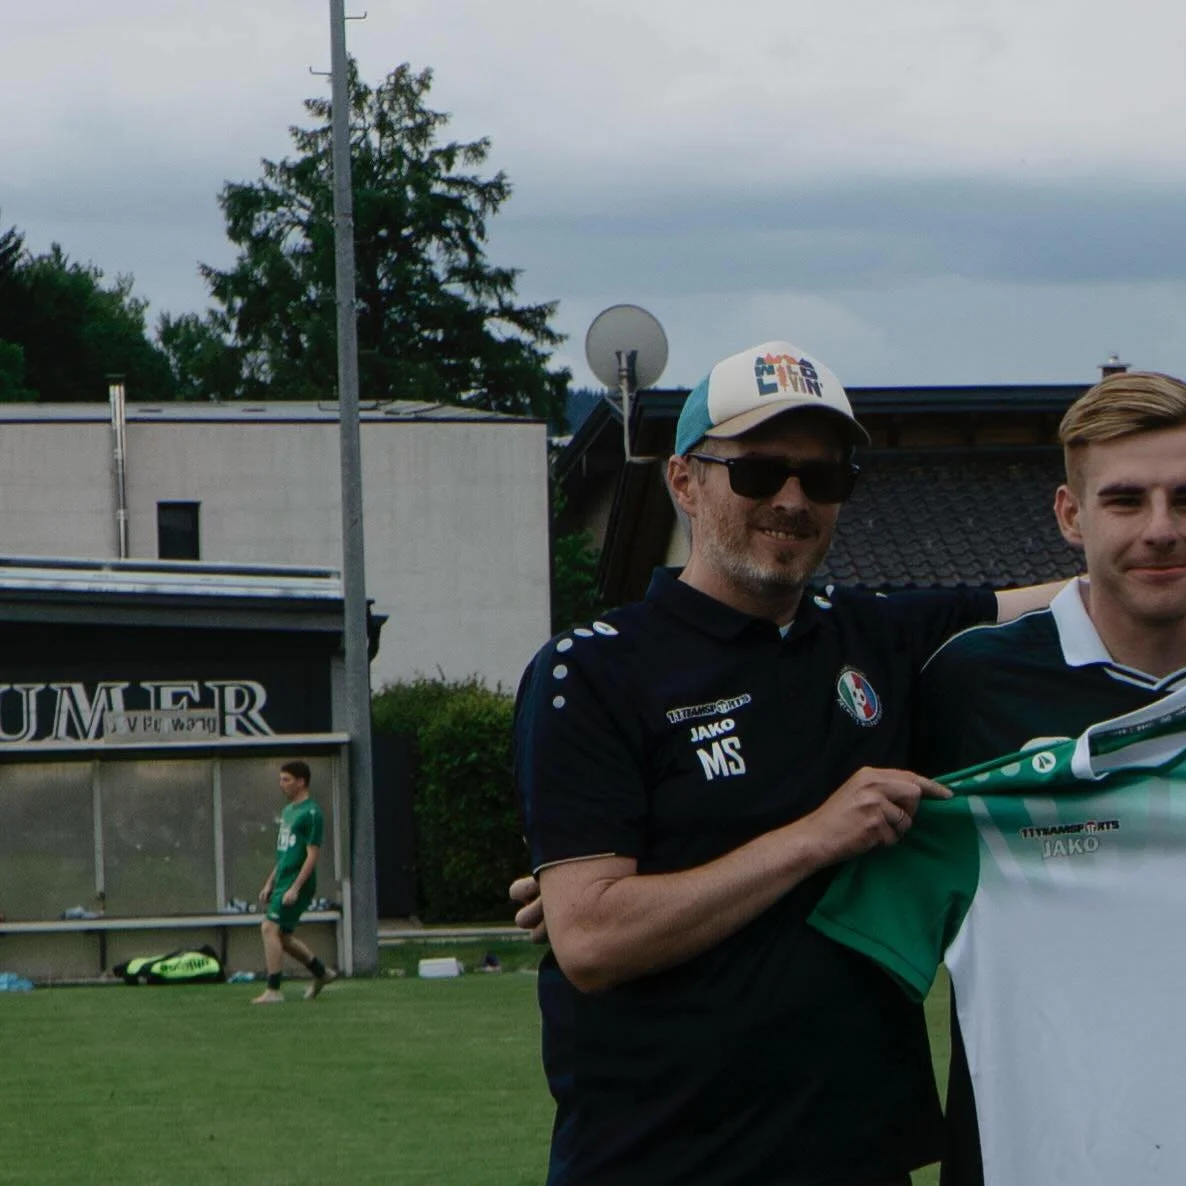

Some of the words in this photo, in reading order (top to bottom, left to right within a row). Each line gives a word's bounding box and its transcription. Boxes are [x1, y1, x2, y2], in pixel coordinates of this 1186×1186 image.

[690, 718, 736, 742] JAKO
[696, 735, 746, 781] MS
[1042, 835, 1099, 858] JAKO
